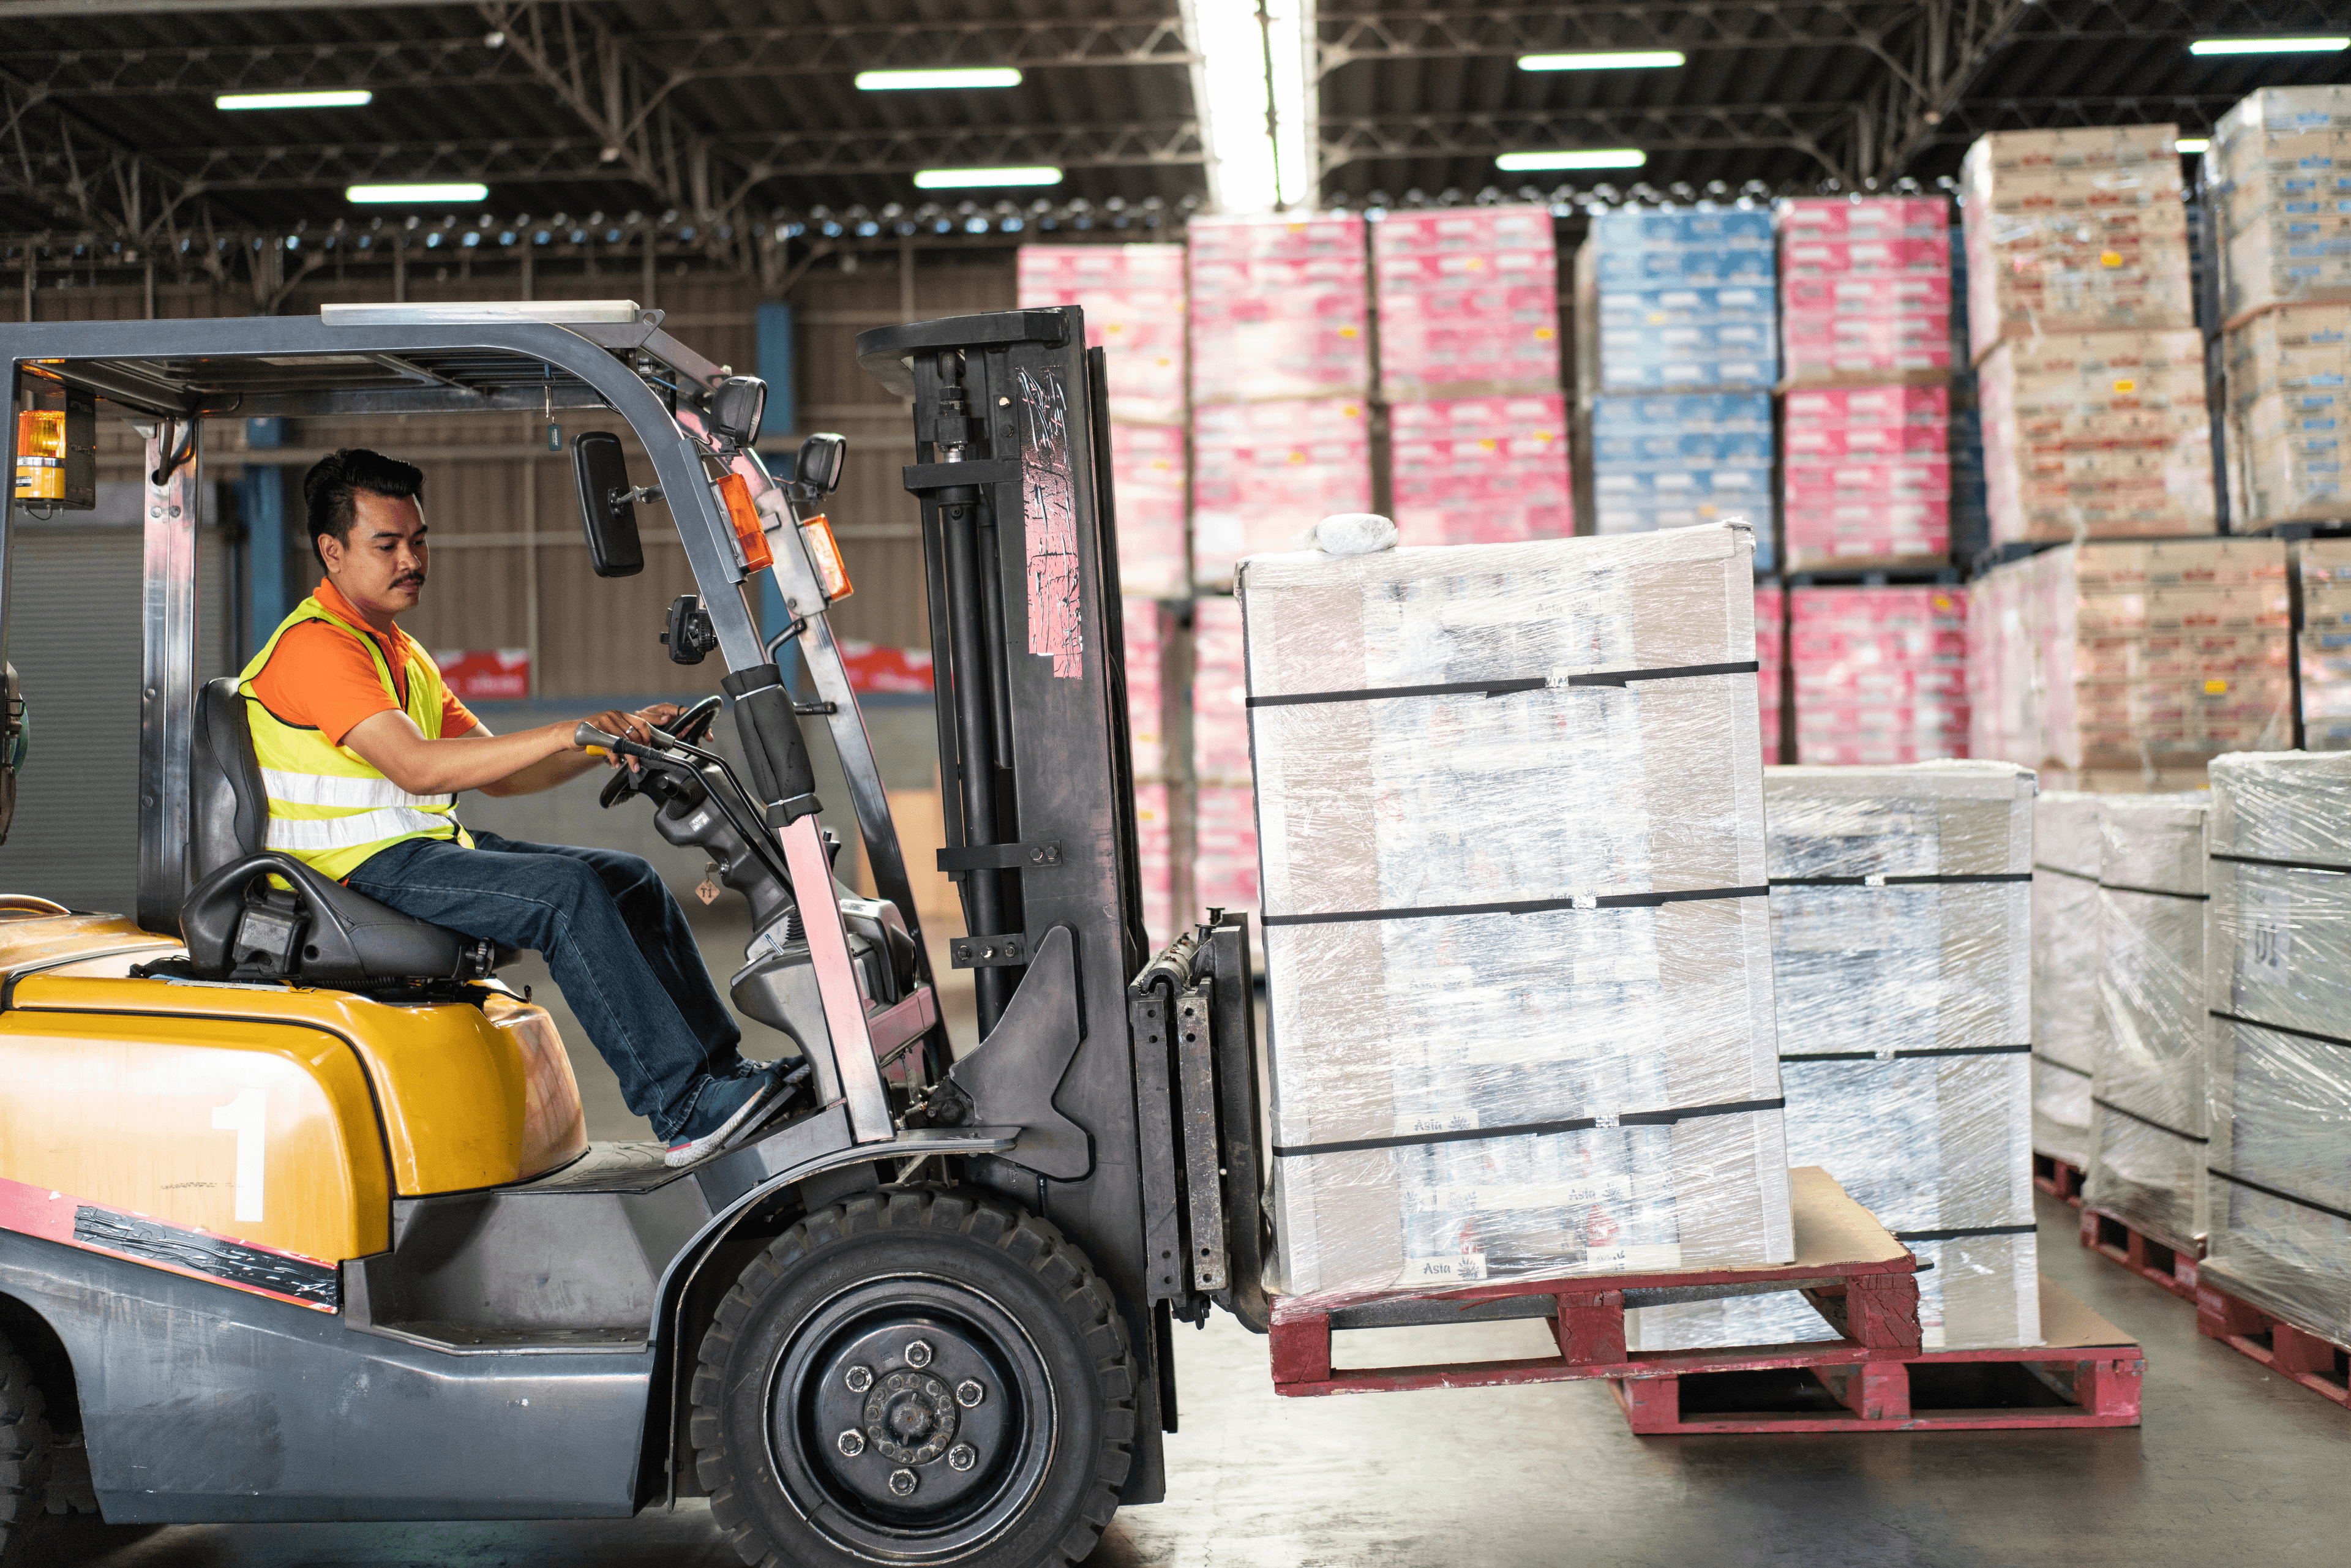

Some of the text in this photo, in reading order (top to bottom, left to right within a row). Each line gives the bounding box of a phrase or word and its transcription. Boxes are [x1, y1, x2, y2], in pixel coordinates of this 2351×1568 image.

[700, 888, 711, 898] T1
[1414, 1119, 1442, 1131] Asia
[212, 1088, 266, 1221] 1
[1423, 1262, 1451, 1275] Asia
